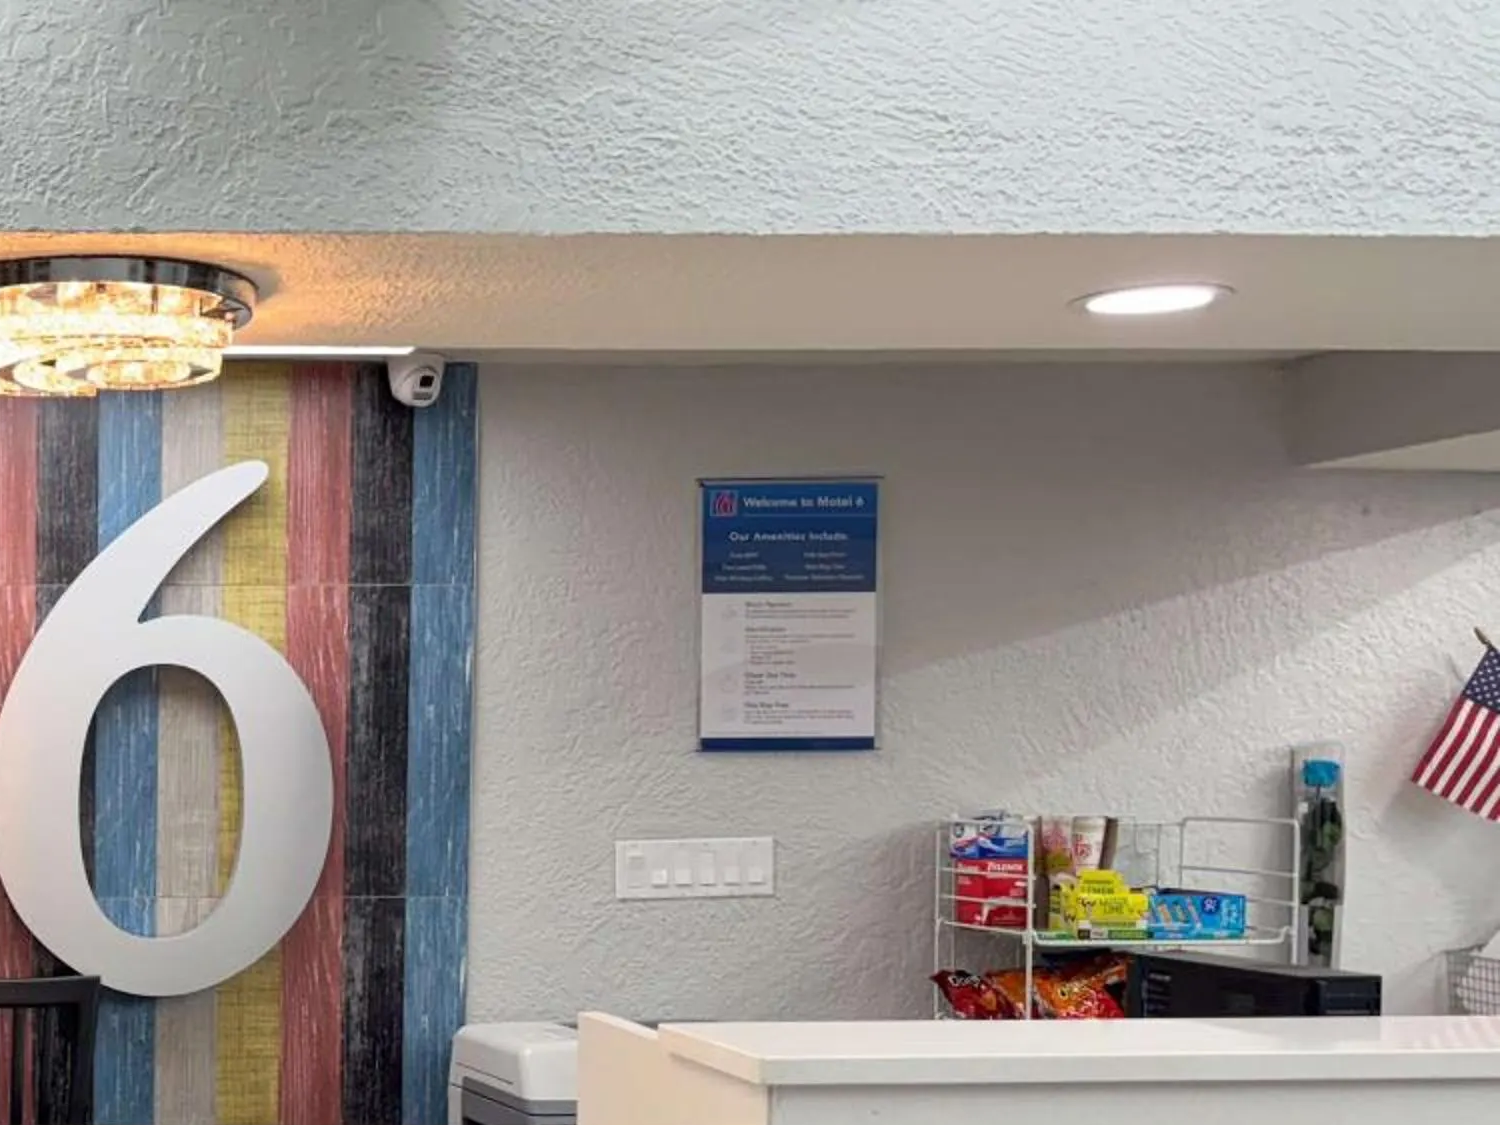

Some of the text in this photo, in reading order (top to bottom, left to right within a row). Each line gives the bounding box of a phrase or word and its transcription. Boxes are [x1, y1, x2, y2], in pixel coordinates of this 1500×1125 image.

[743, 496, 798, 508] Welcome
[801, 496, 814, 507] to
[817, 495, 853, 508] Motel
[728, 531, 750, 542] Our
[753, 530, 806, 542] Amenities
